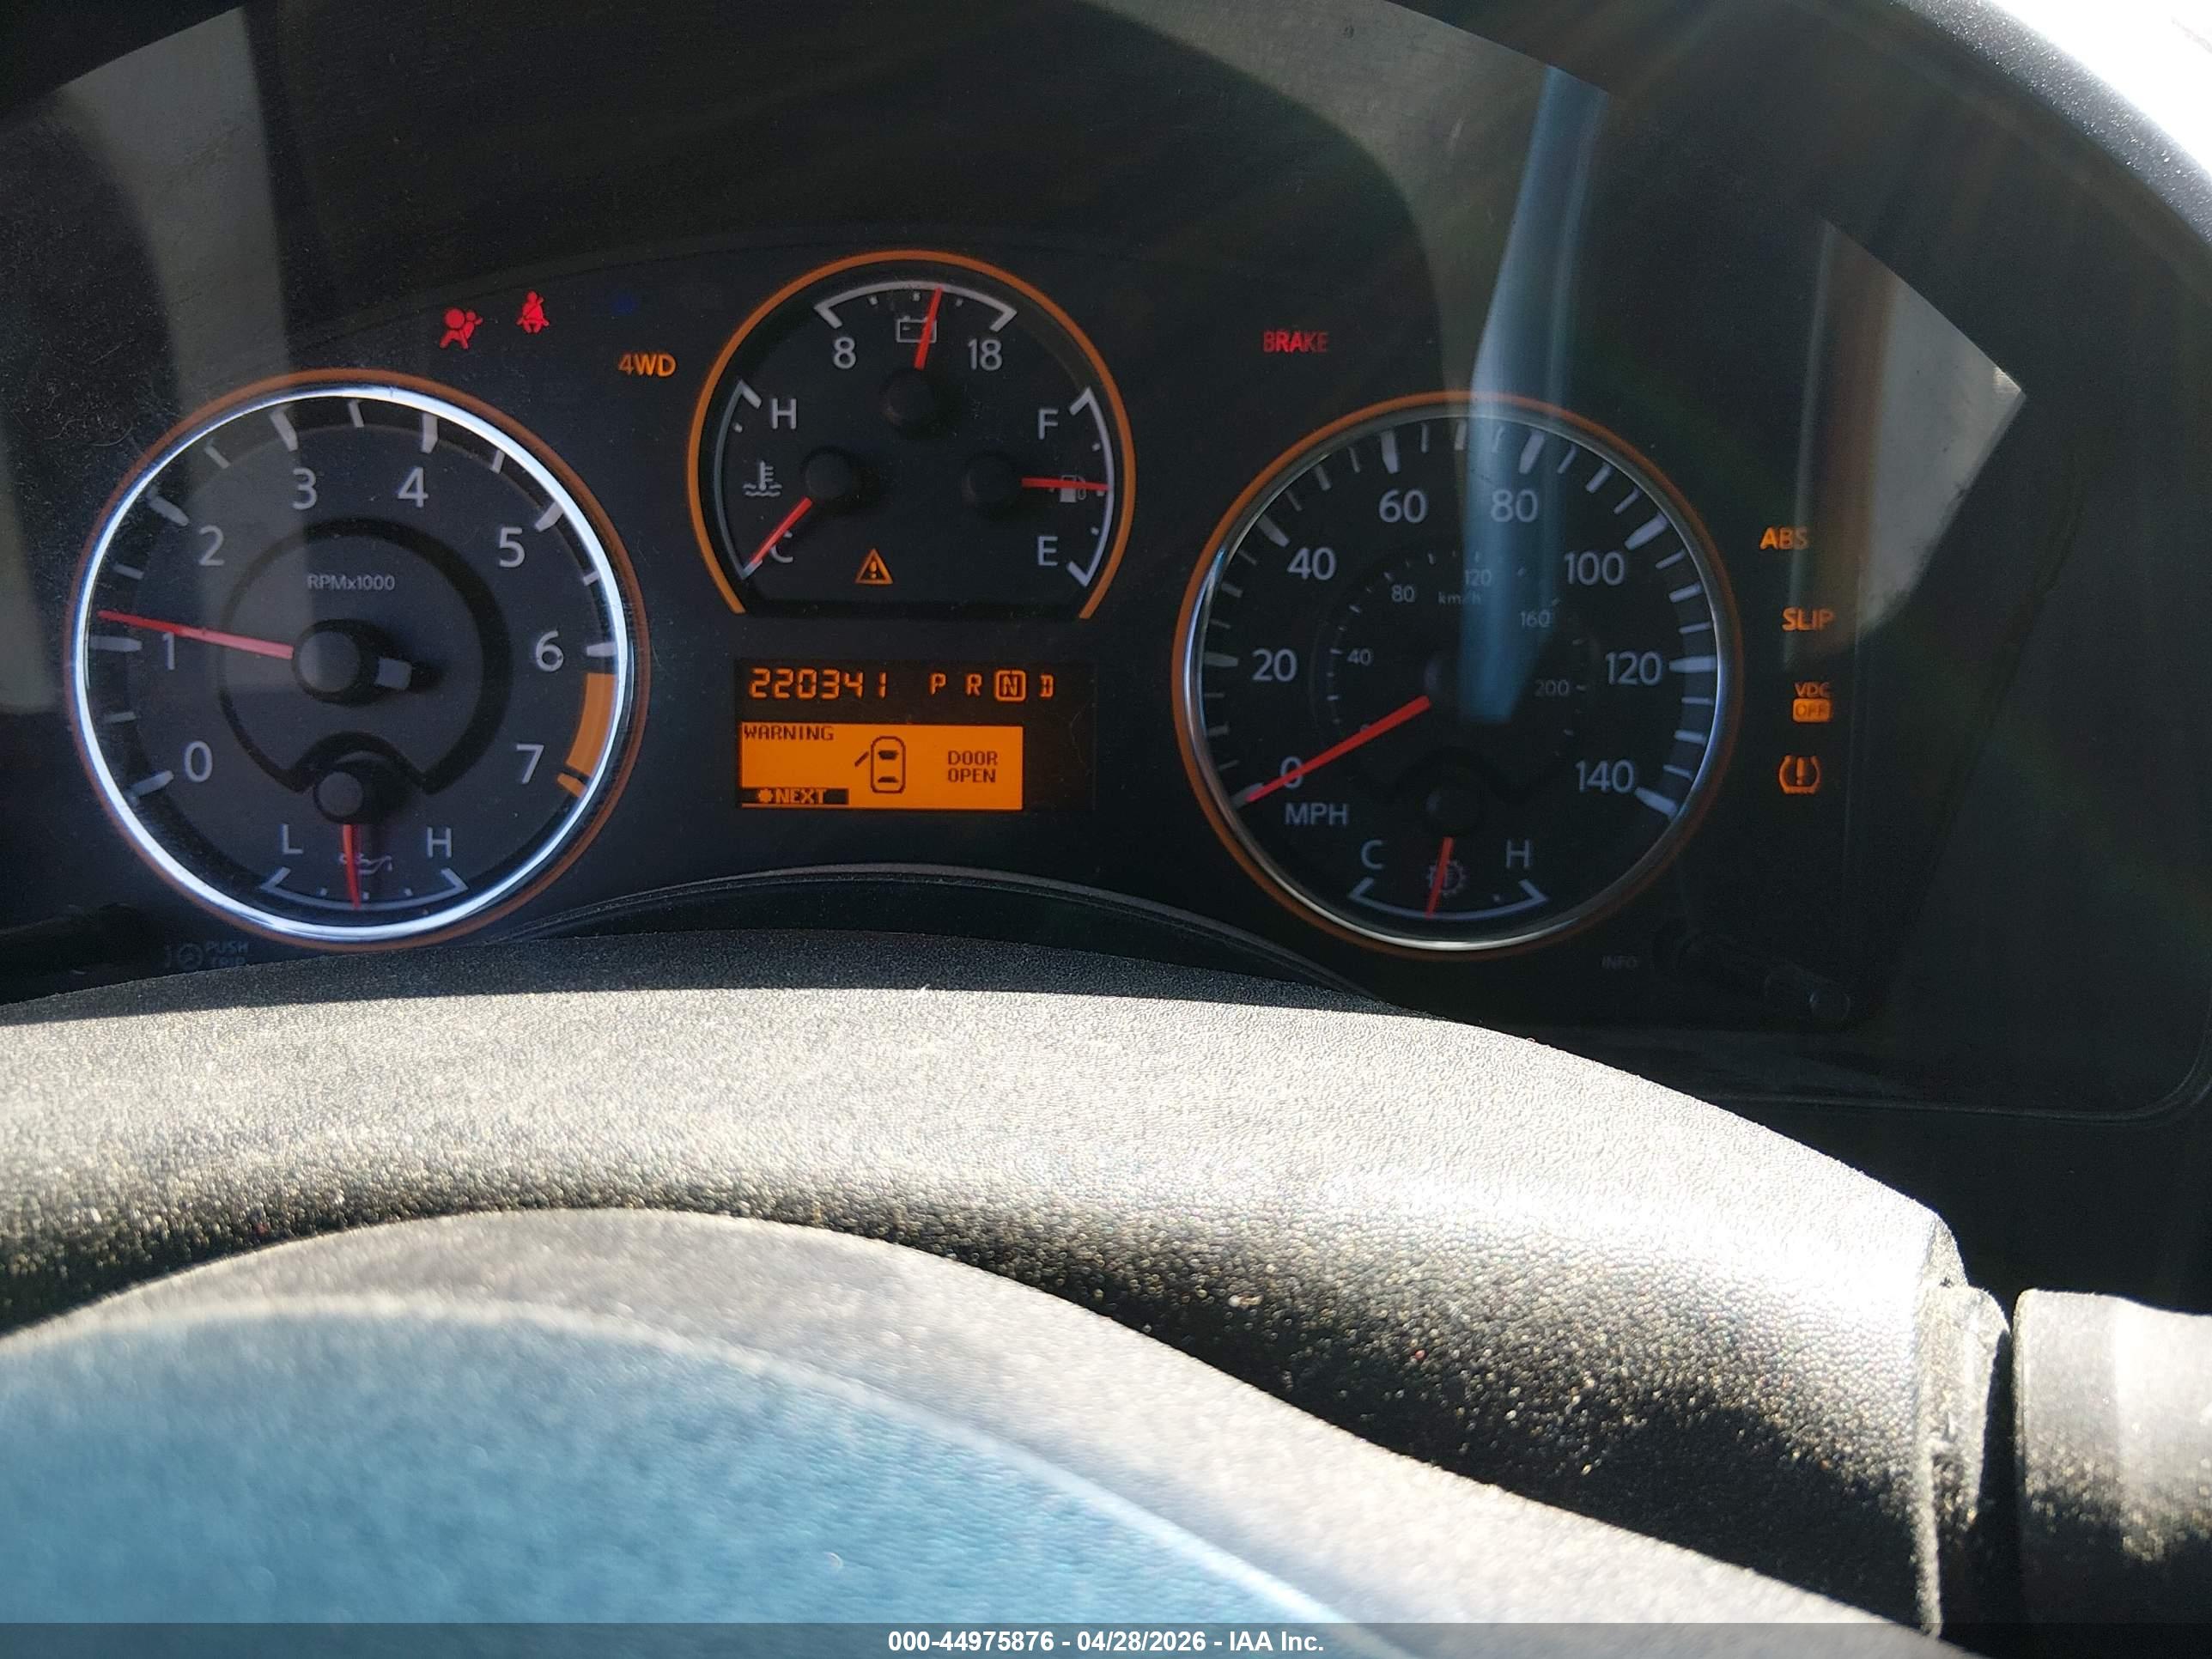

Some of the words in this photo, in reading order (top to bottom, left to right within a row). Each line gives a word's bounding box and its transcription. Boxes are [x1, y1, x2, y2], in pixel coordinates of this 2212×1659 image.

[833, 337, 856, 369] 8
[968, 339, 1003, 371] 18
[1263, 330, 1328, 353] BRAKE
[618, 353, 677, 377] 4WD
[772, 398, 797, 428] H
[1038, 409, 1058, 439] F
[294, 470, 317, 509] 3
[398, 468, 428, 507] 4
[1379, 490, 1427, 523] 60
[1490, 489, 1538, 523] 80
[199, 527, 224, 565] 2
[499, 527, 525, 567] 5
[1037, 536, 1058, 566] E
[1759, 527, 1809, 550] ABS
[1288, 547, 1336, 580] 40
[1465, 569, 1492, 586] 120
[1565, 550, 1625, 585] 100
[307, 574, 395, 591] RPMx1000
[1391, 585, 1416, 603] 80
[1437, 591, 1482, 605] km/h
[1519, 611, 1551, 628] 160
[1782, 607, 1835, 631] SLIP
[535, 631, 563, 671] 6
[1252, 648, 1297, 683] 20
[1346, 647, 1373, 665] 40
[749, 668, 890, 700] 220341
[1605, 652, 1662, 686] 120
[930, 672, 946, 696] P
[966, 673, 982, 696] R
[1000, 675, 1019, 696] N
[1039, 674, 1054, 698] D
[1535, 679, 1571, 696] 200
[1795, 682, 1830, 697] VDC
[1796, 702, 1829, 718] OFF
[744, 725, 834, 741] WARNING
[185, 742, 212, 781] 0
[516, 744, 545, 782] 7
[948, 750, 998, 766] DOOR
[948, 769, 996, 783] OPEN
[1577, 759, 1634, 793] 140
[775, 788, 828, 805] NEXT
[1285, 803, 1348, 825] MPH
[282, 824, 302, 854] L
[428, 827, 452, 857] H
[1360, 839, 1383, 871] C
[1506, 840, 1530, 869] H
